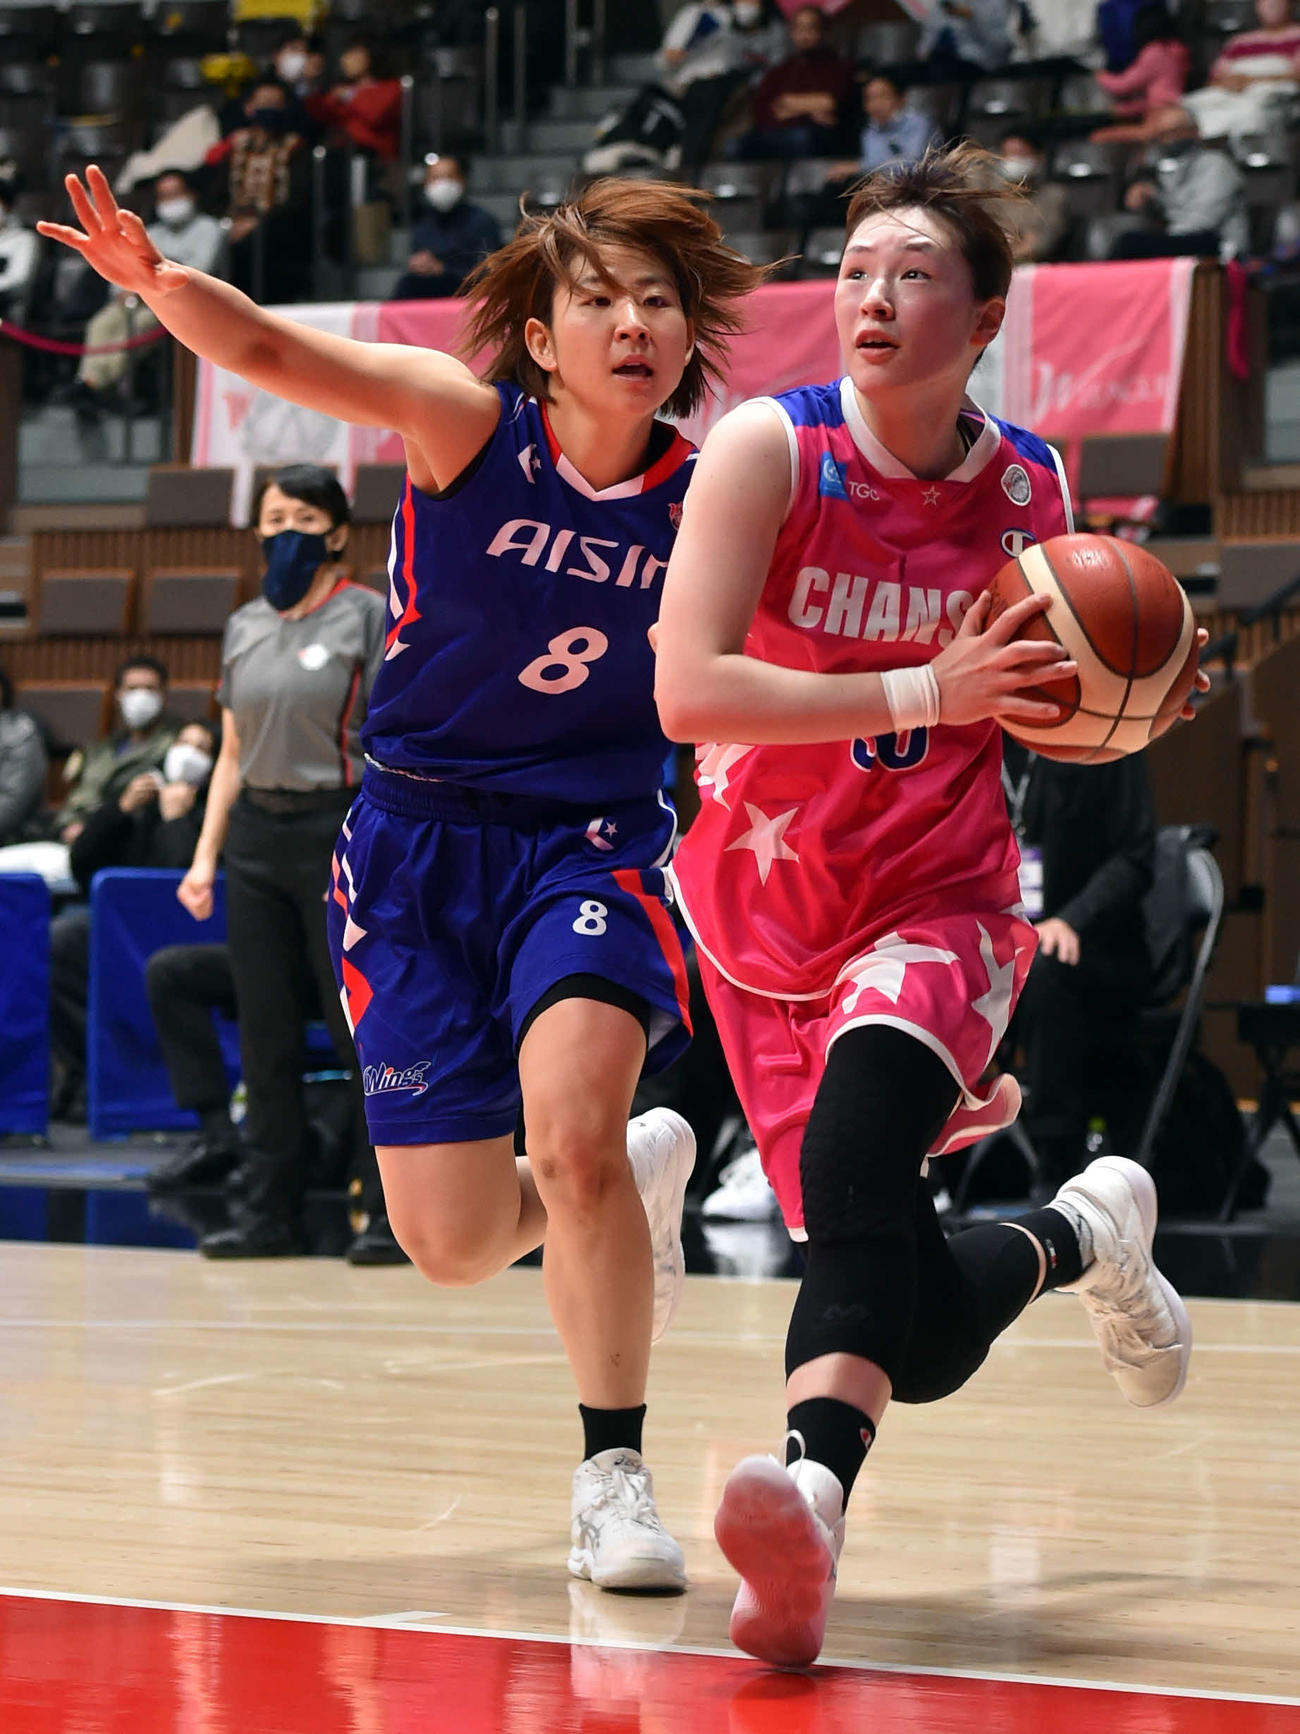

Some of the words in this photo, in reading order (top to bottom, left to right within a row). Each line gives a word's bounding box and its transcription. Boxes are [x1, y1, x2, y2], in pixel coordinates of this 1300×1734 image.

[517, 626, 609, 694] 8
[572, 900, 608, 936] 8
[363, 1061, 432, 1096] Wings
